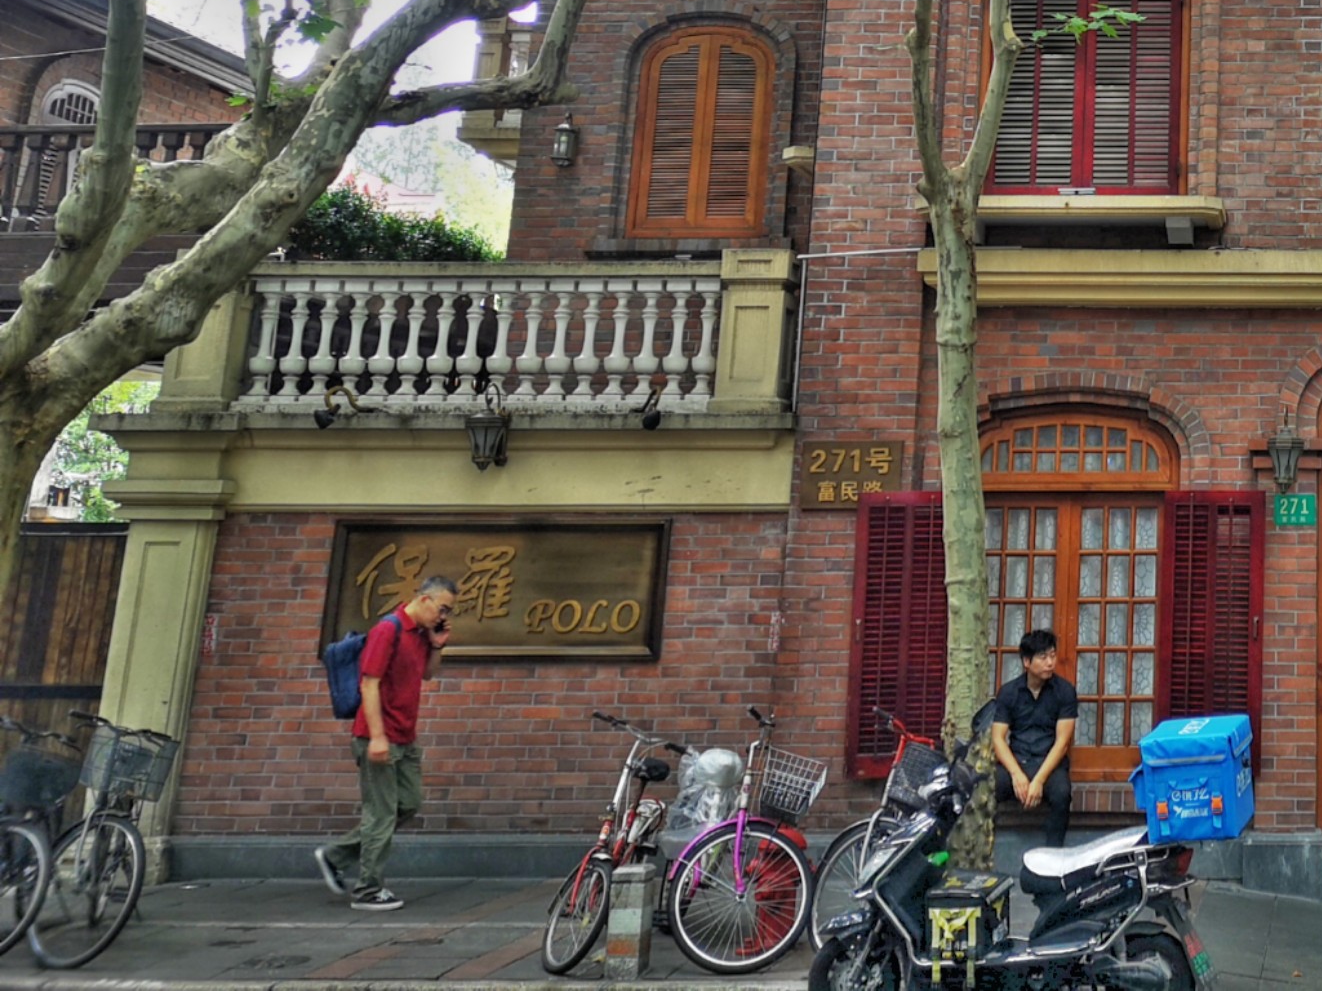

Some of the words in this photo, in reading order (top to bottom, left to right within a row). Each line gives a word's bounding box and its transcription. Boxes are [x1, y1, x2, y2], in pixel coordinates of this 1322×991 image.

[809, 447, 893, 474] 271号
[1280, 497, 1309, 515] 271
[524, 599, 641, 634] POLO
